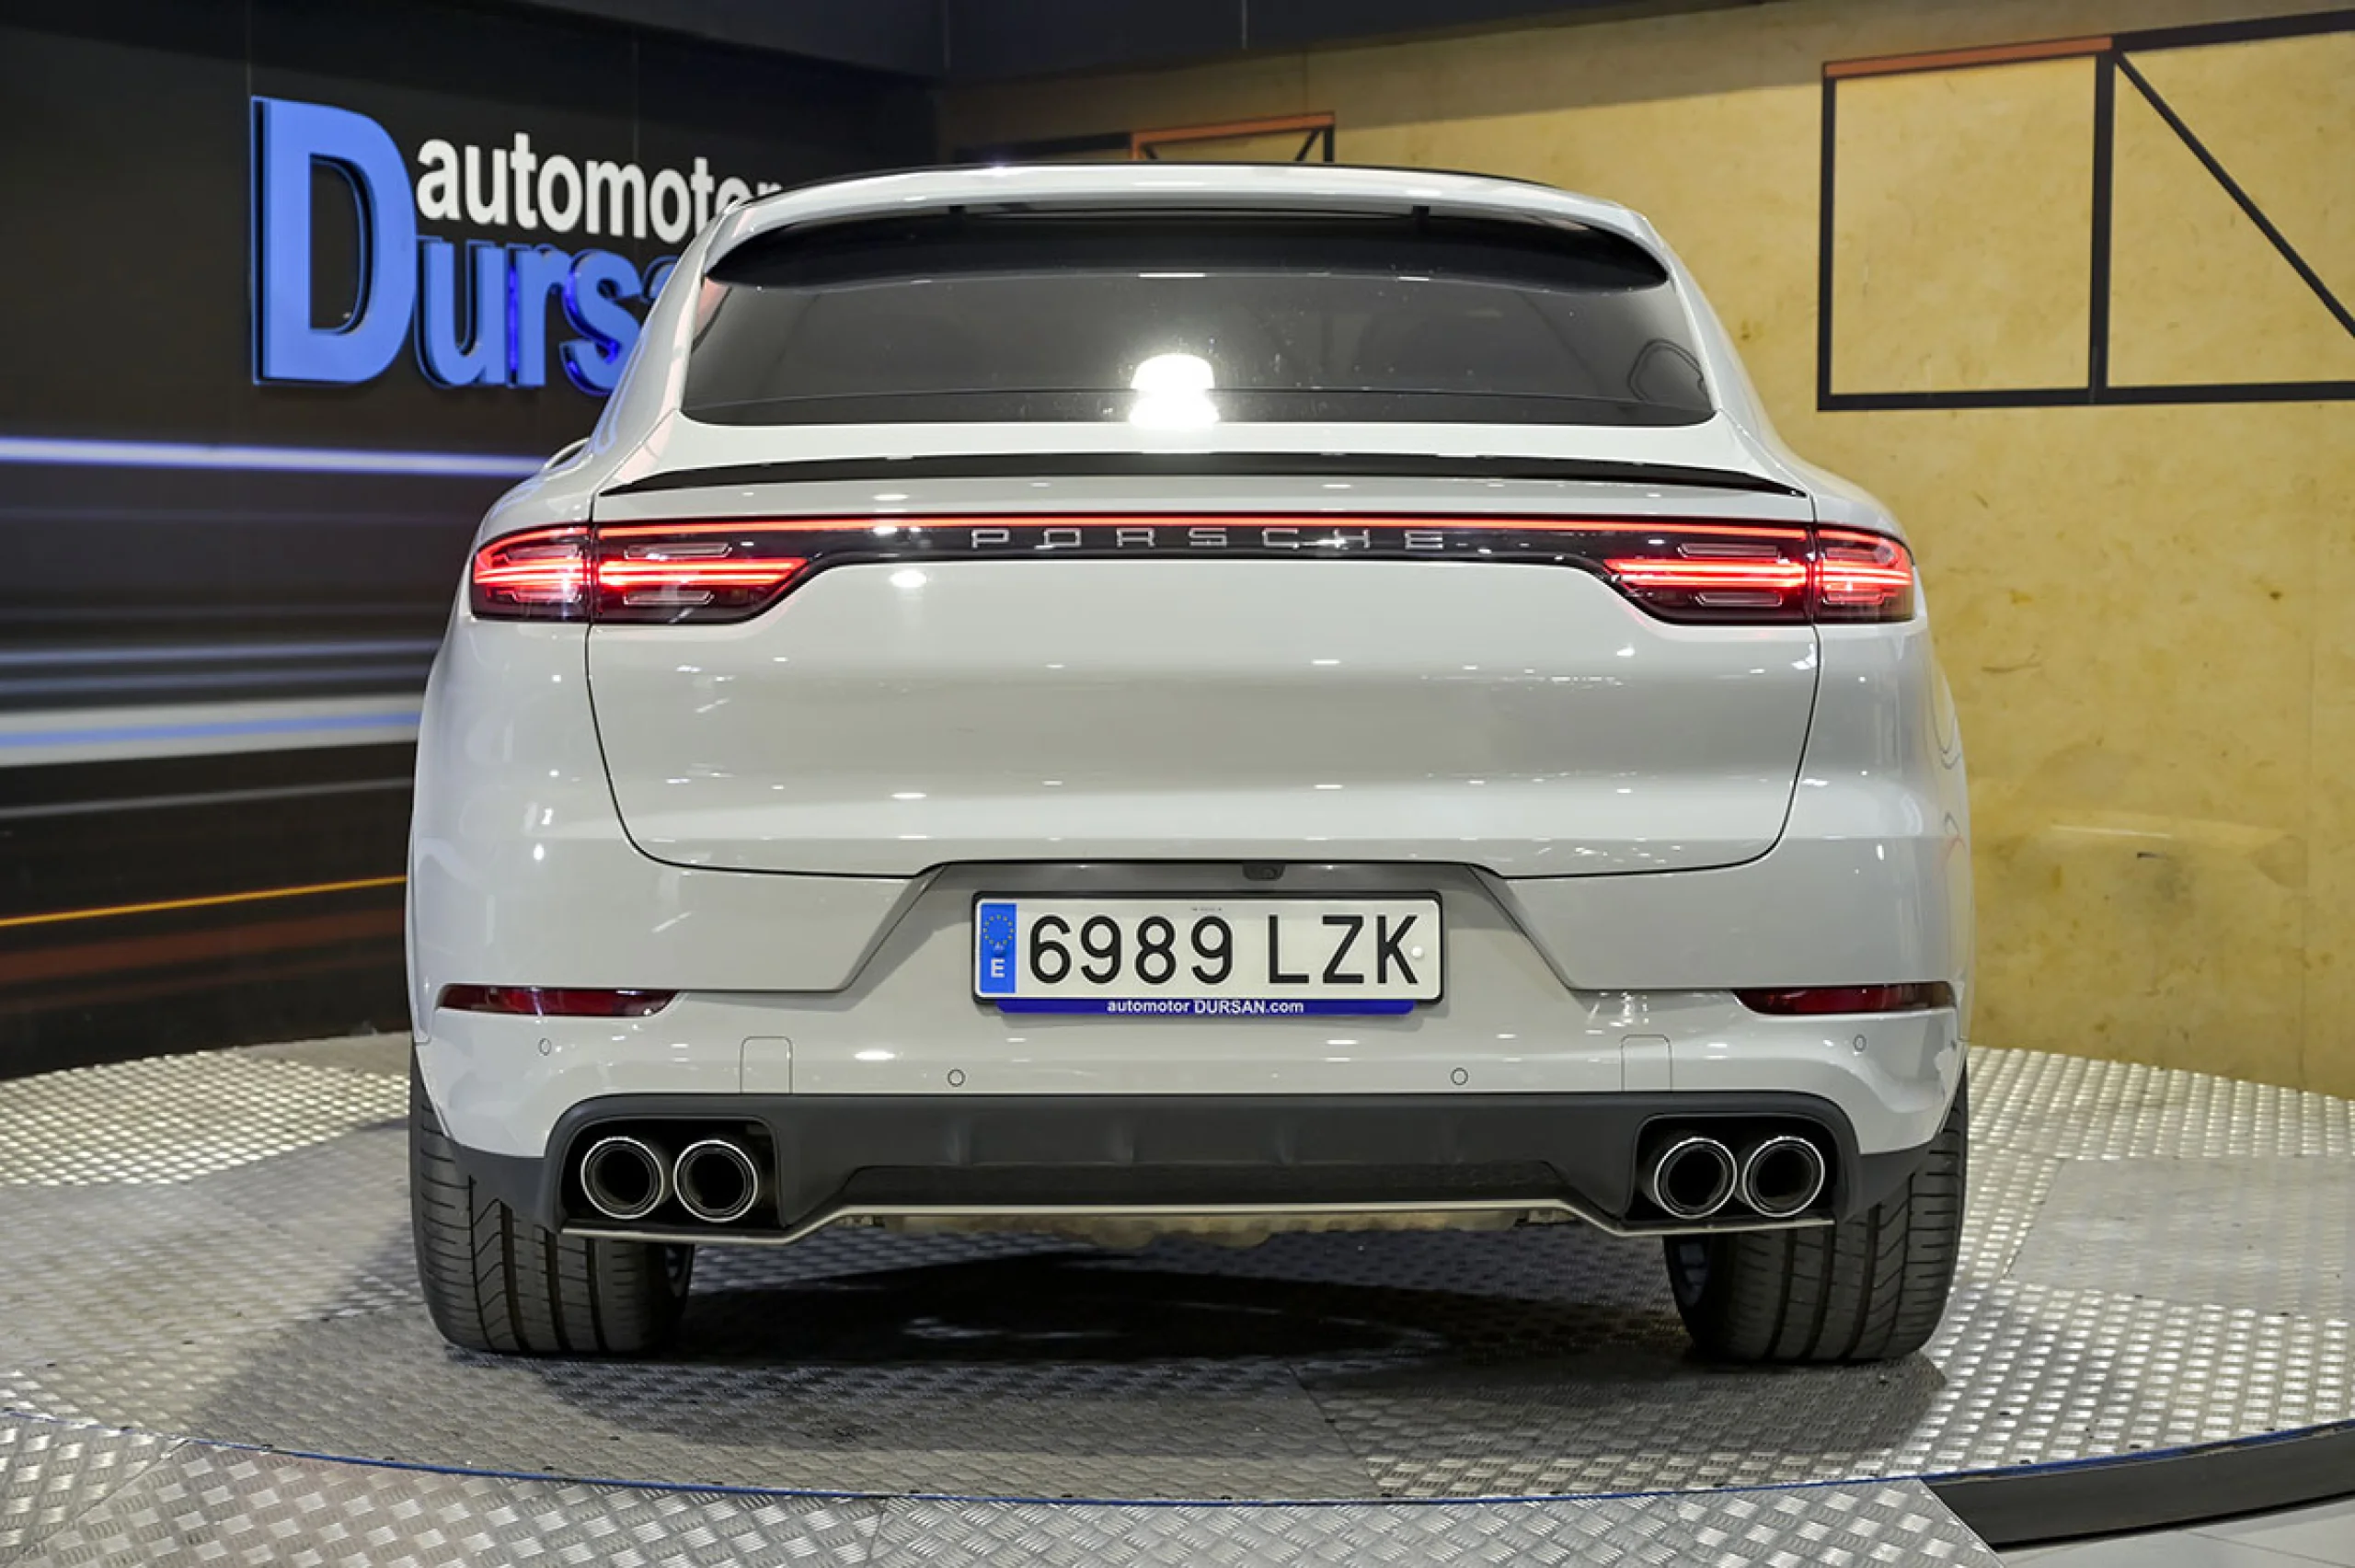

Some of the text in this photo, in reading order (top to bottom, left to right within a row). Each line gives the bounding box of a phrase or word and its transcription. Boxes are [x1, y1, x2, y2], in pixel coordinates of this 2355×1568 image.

[416, 132, 782, 245] automot
[250, 95, 678, 396] Durs
[971, 527, 1444, 549] PORSCHE
[990, 957, 1005, 979] E
[1028, 914, 1419, 985] 6989 LZK
[1107, 999, 1304, 1014] automotor DURSAN.com
